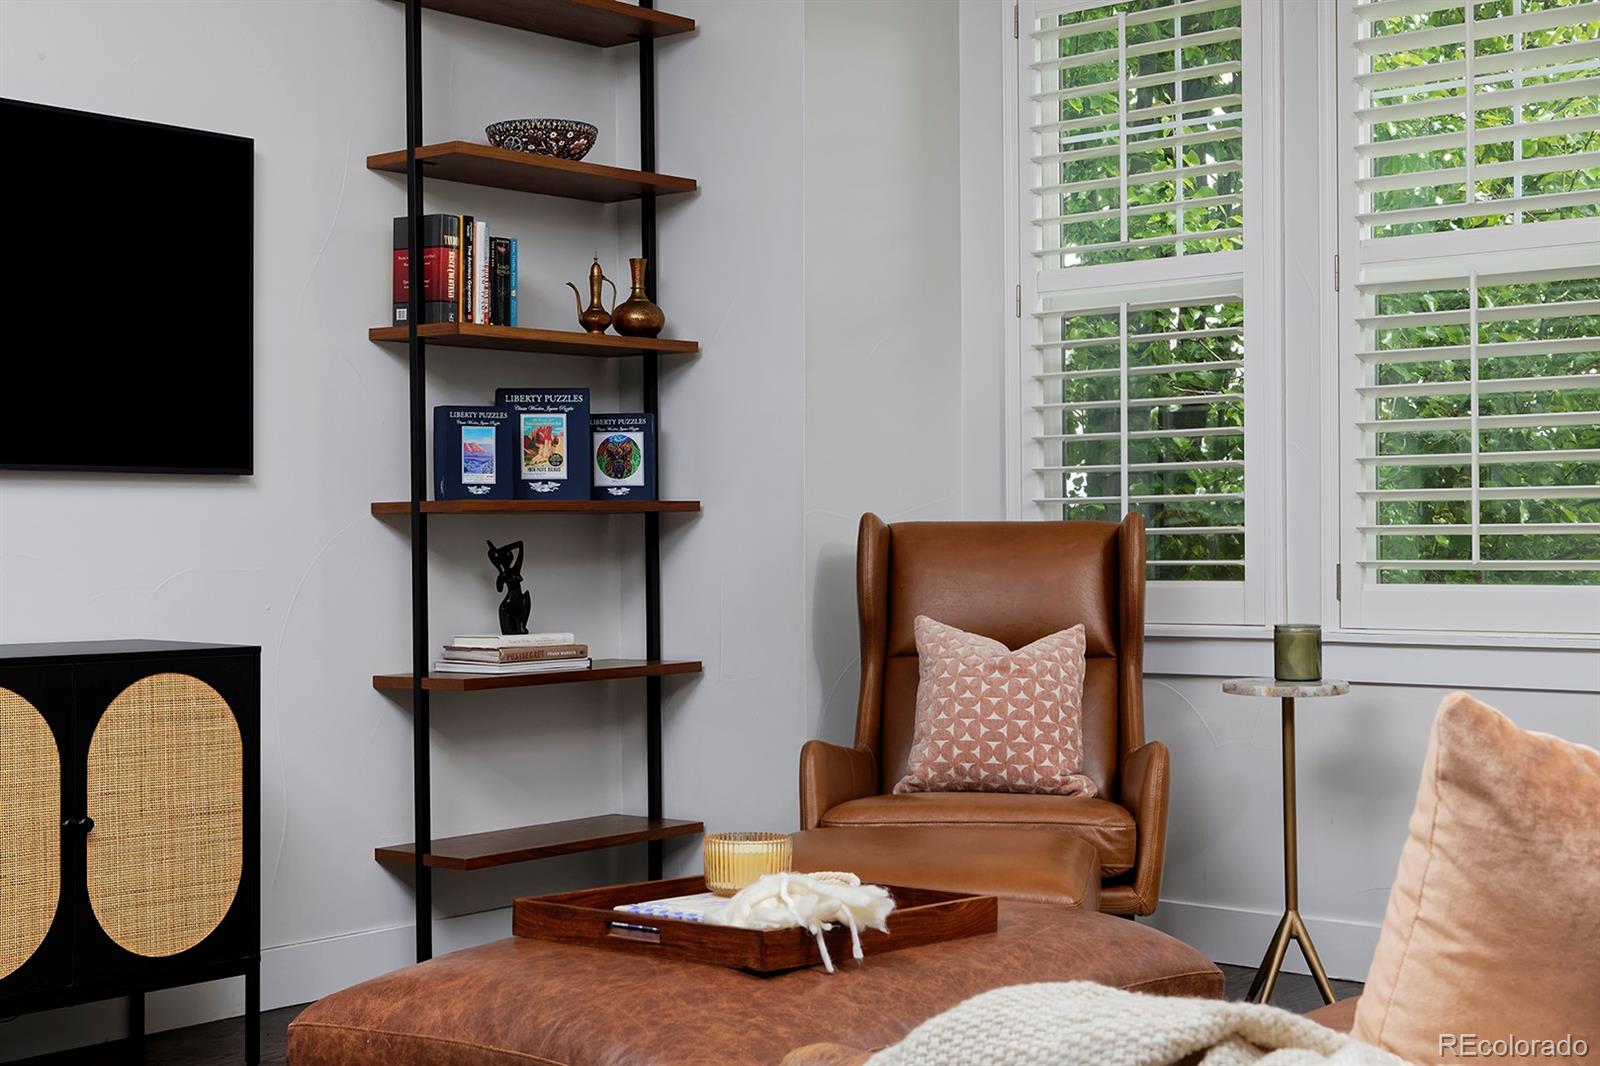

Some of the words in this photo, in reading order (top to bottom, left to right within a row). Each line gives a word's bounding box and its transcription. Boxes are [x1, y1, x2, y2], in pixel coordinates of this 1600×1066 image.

[505, 394, 542, 403] LIBERTY
[544, 394, 584, 403] PUZZLES
[479, 411, 508, 419] PUZZLES
[590, 418, 616, 426] LIBERTY
[617, 418, 647, 426] PUZZLES
